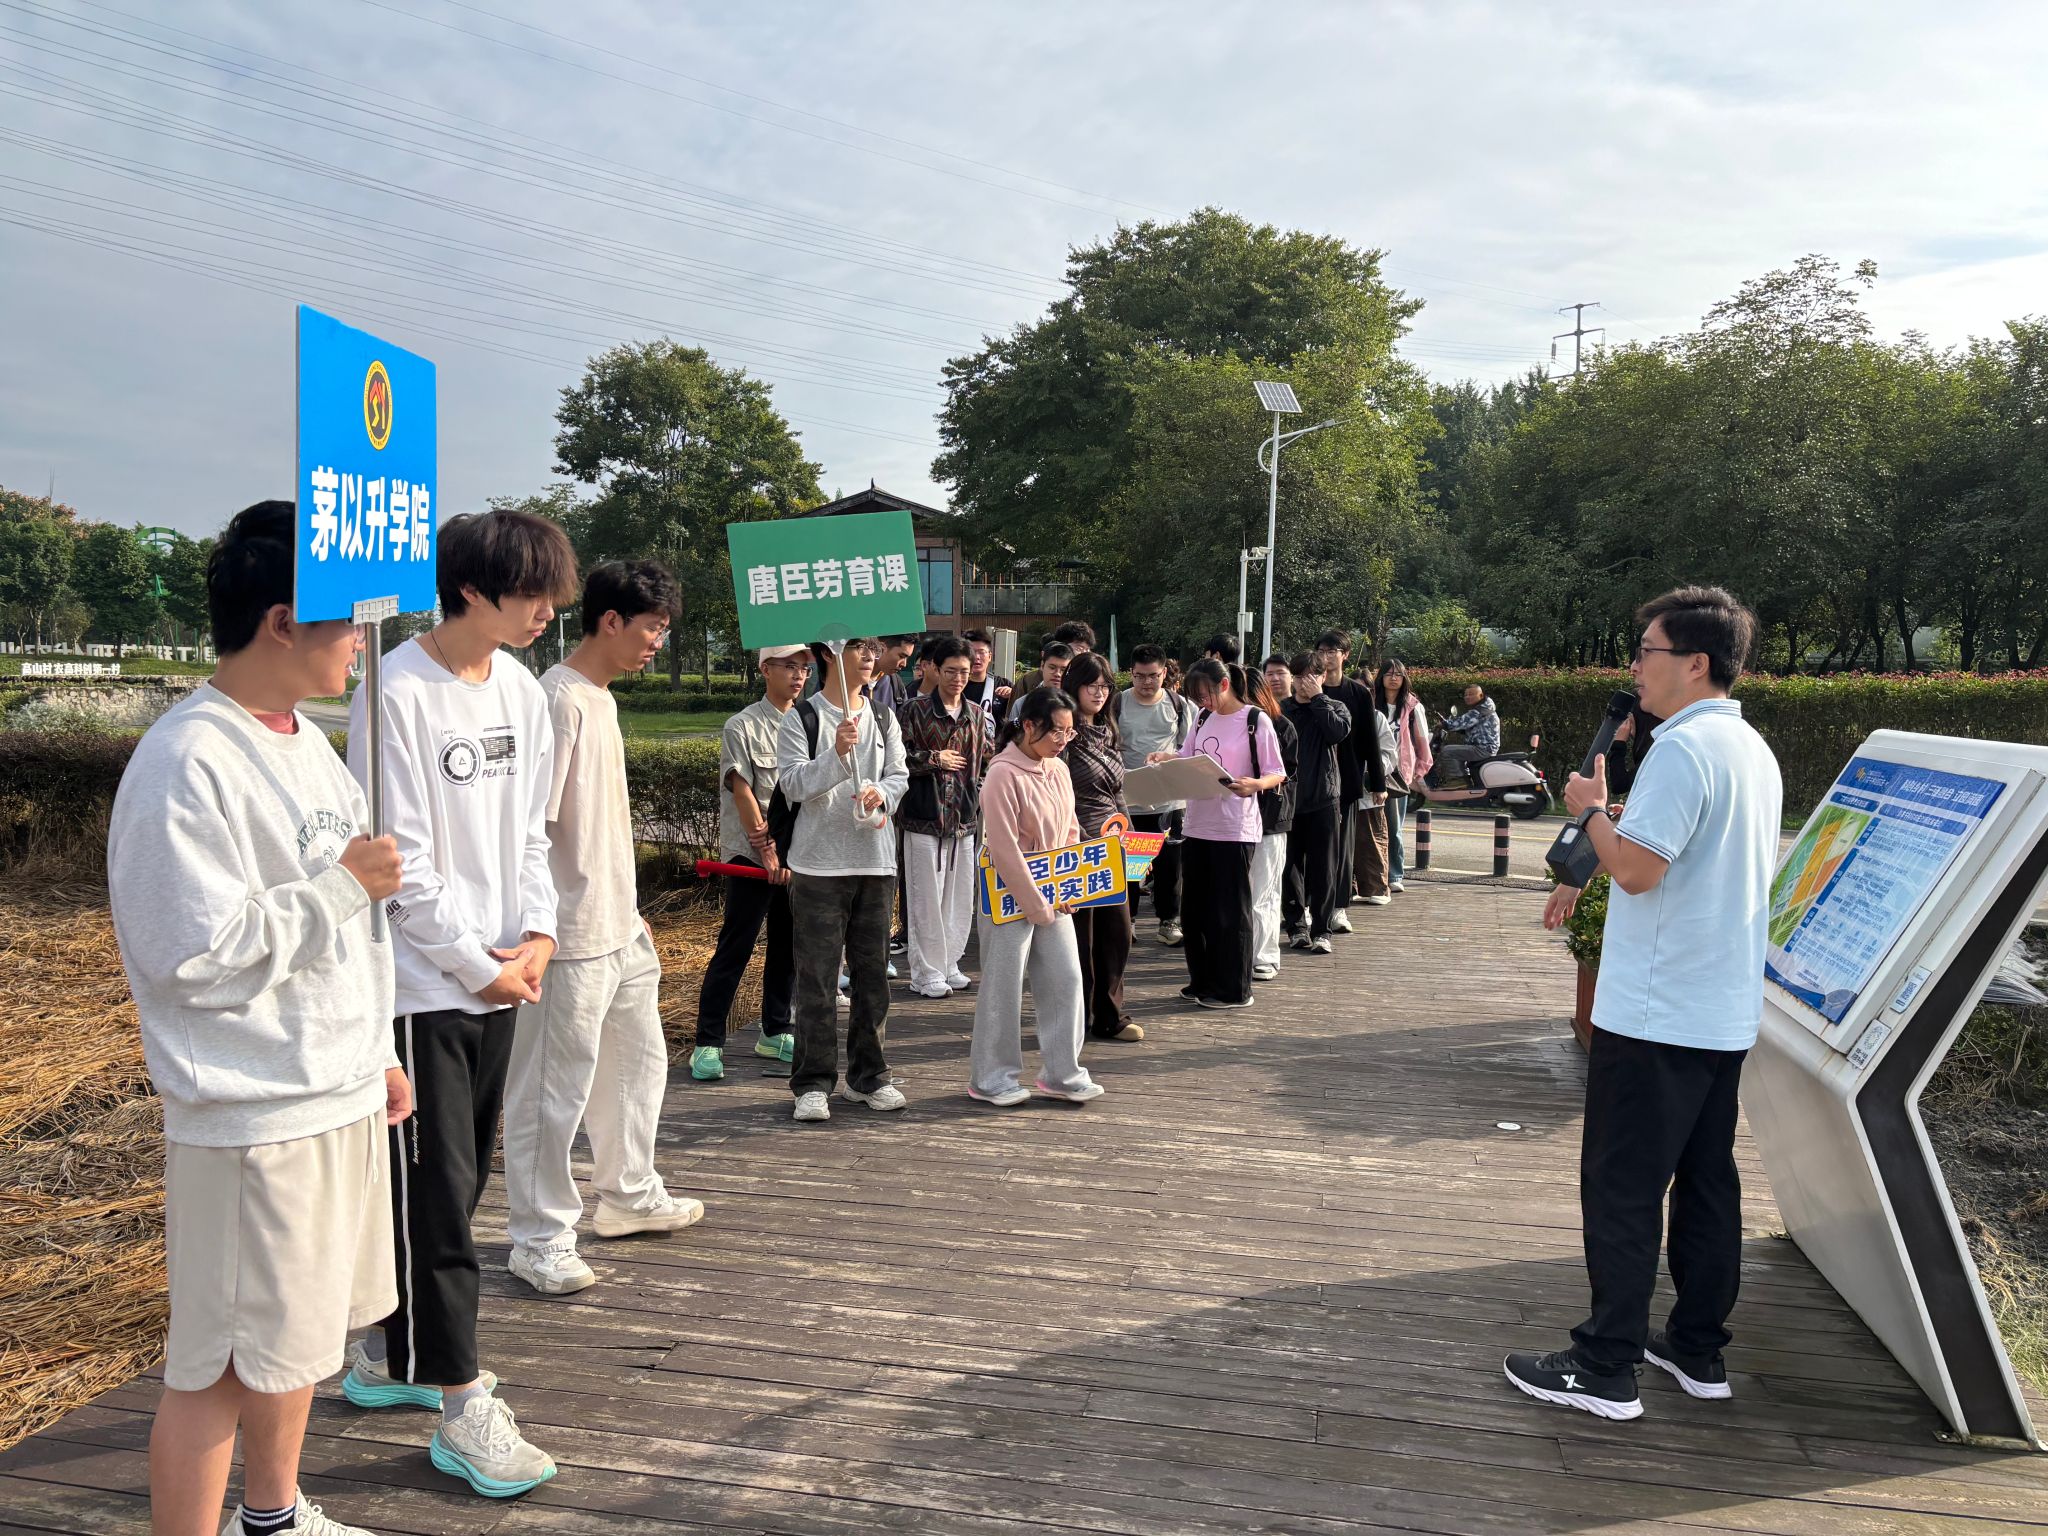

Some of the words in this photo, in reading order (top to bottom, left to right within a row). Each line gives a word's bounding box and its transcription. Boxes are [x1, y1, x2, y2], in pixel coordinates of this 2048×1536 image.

[310, 465, 430, 562] 茅以升学院
[747, 553, 910, 606] 唐臣劳育课
[996, 843, 1107, 890] 臣少年
[386, 899, 402, 918] UG
